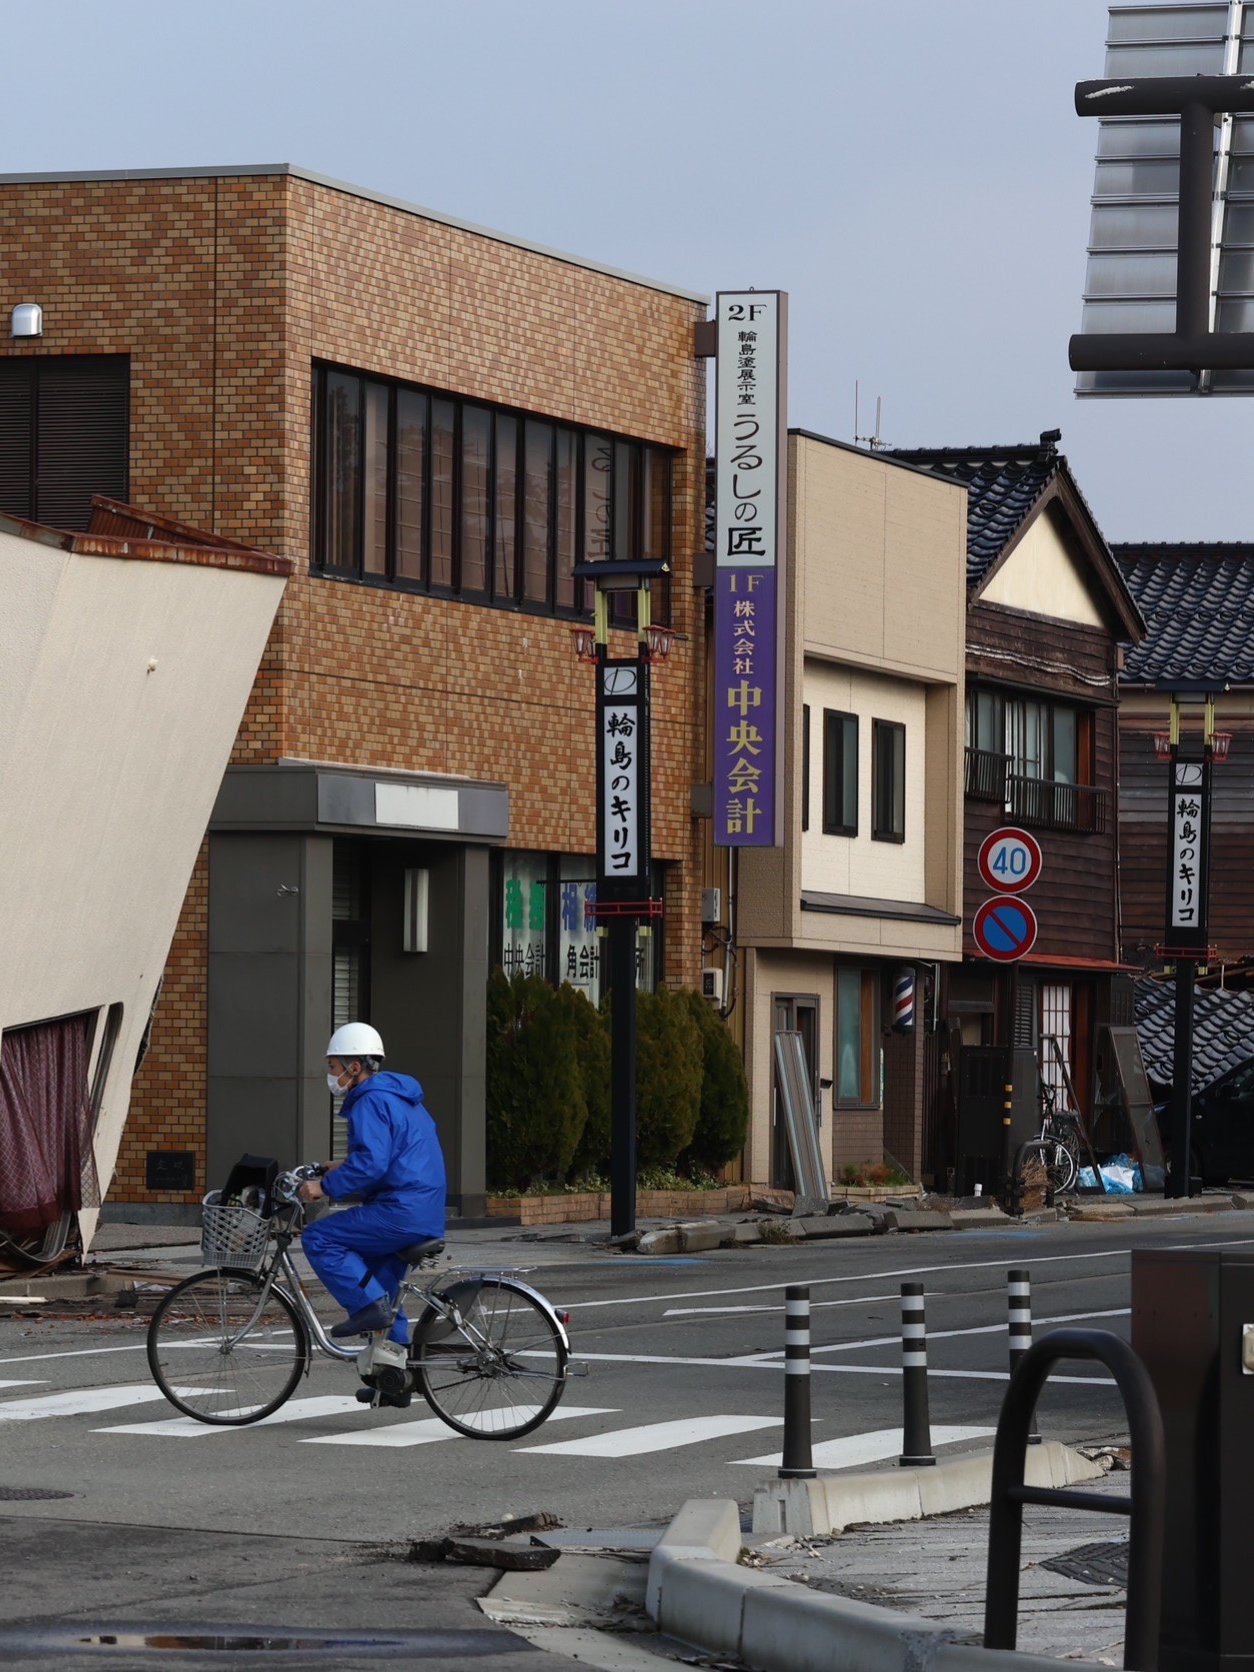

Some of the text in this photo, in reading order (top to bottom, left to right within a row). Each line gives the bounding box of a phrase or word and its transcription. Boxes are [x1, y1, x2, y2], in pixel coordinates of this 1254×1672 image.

[728, 304, 767, 321] 2F
[727, 331, 766, 556] 輪島塗展示室 うるしの匠
[729, 574, 764, 592] 1F
[726, 600, 763, 834] 株式会社 中央会計
[606, 712, 636, 870] 輪島のキリコ
[993, 847, 1026, 875] 40
[1176, 798, 1200, 922] 輪島のキリコ
